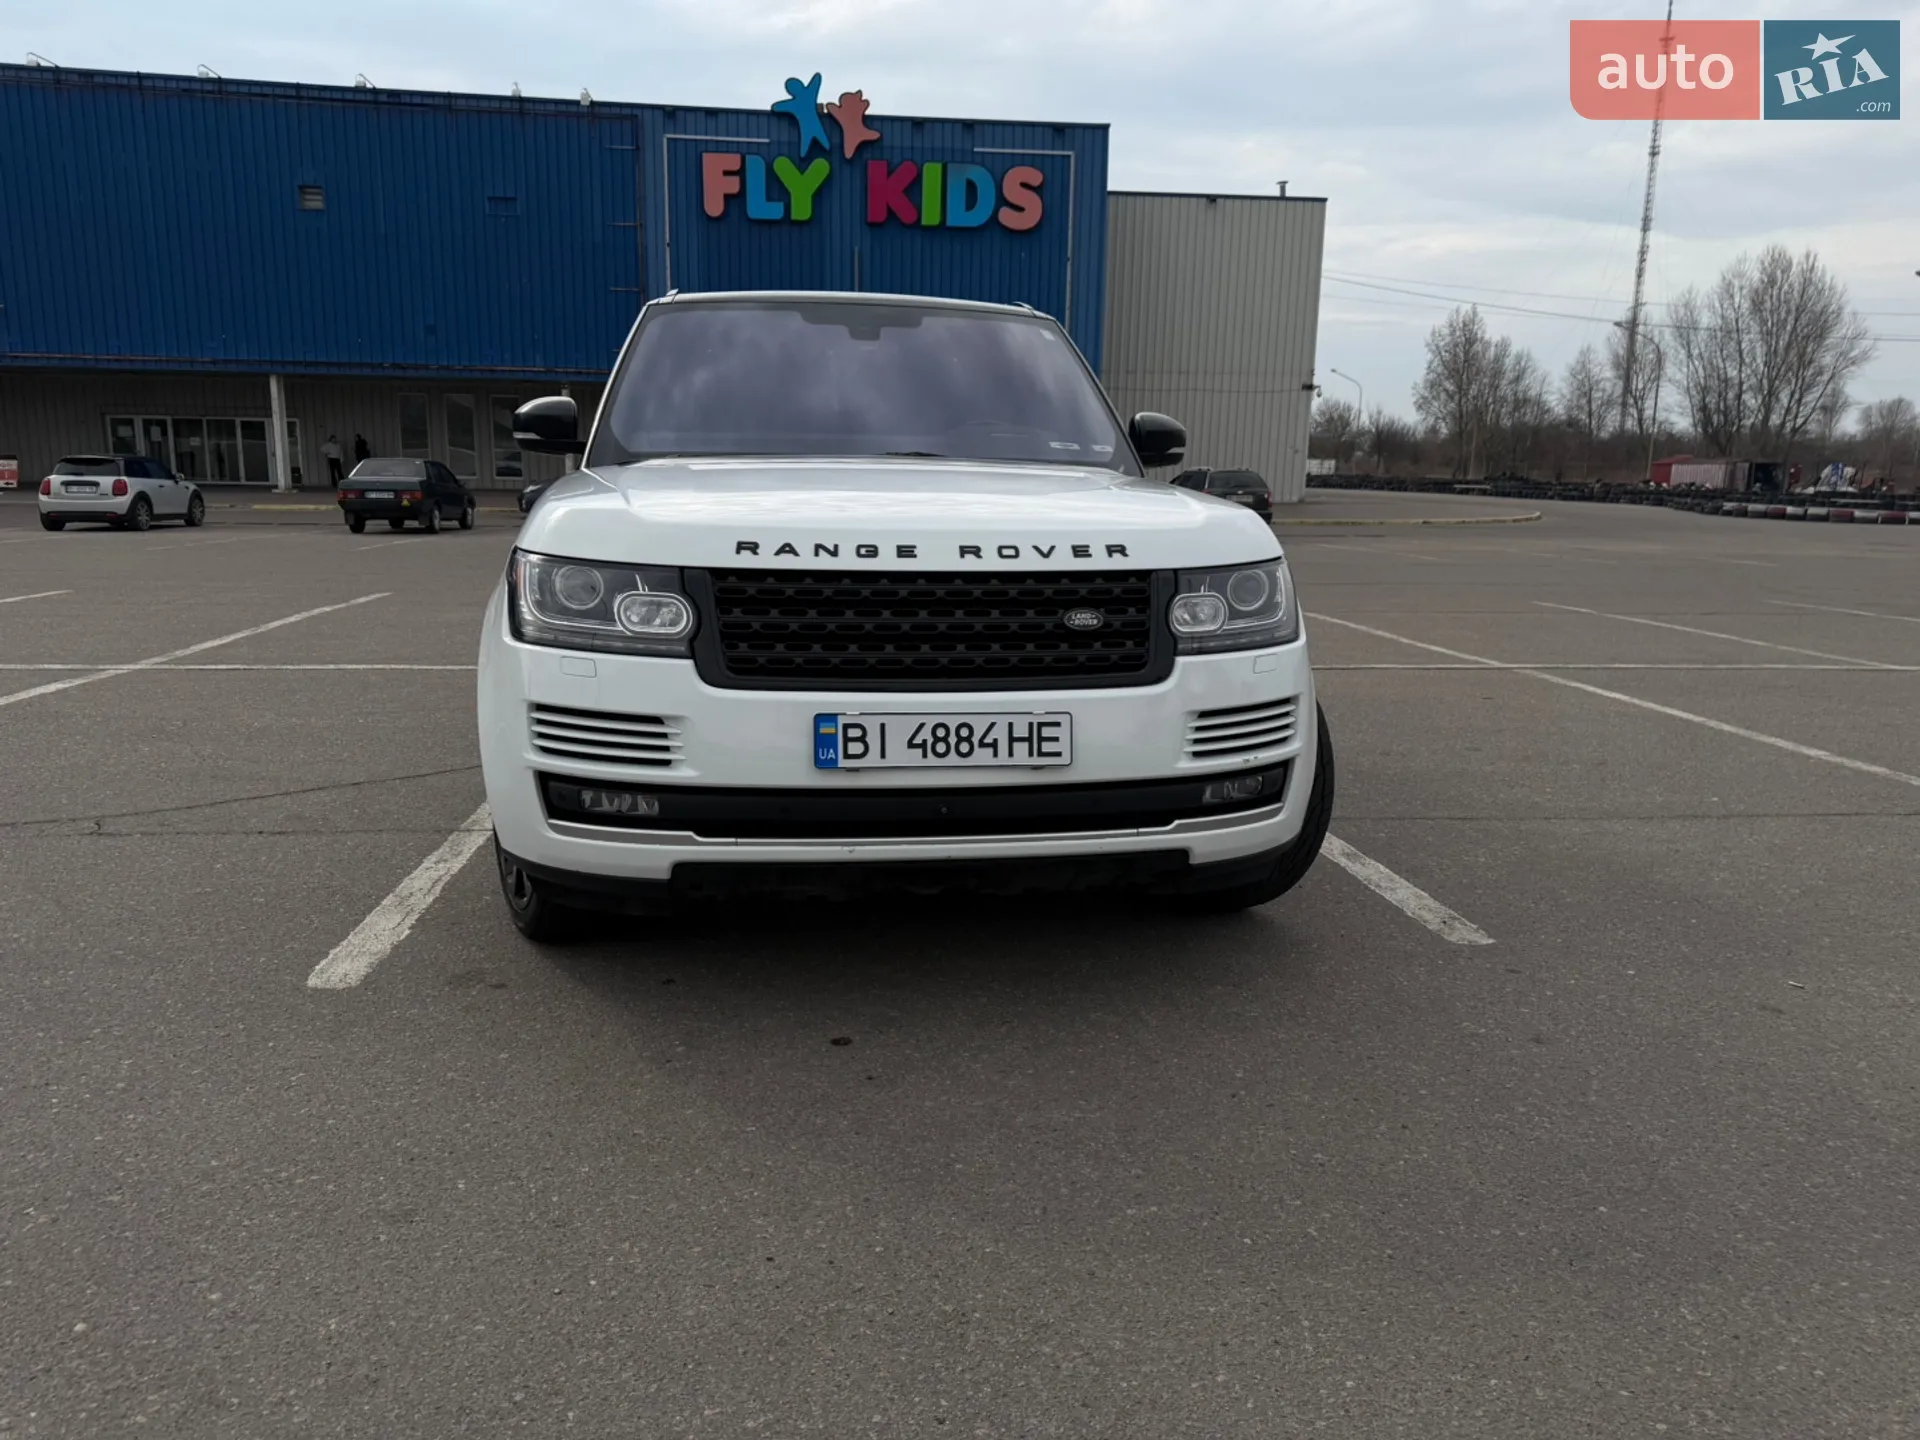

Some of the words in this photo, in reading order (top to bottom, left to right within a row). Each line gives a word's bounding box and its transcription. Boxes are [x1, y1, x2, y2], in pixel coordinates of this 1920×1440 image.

[701, 152, 831, 221] FLY
[866, 159, 1044, 232] KIDS
[735, 541, 918, 559] RANGE
[959, 544, 1130, 560] ROVER
[818, 748, 836, 760] UA
[842, 722, 886, 760] BI
